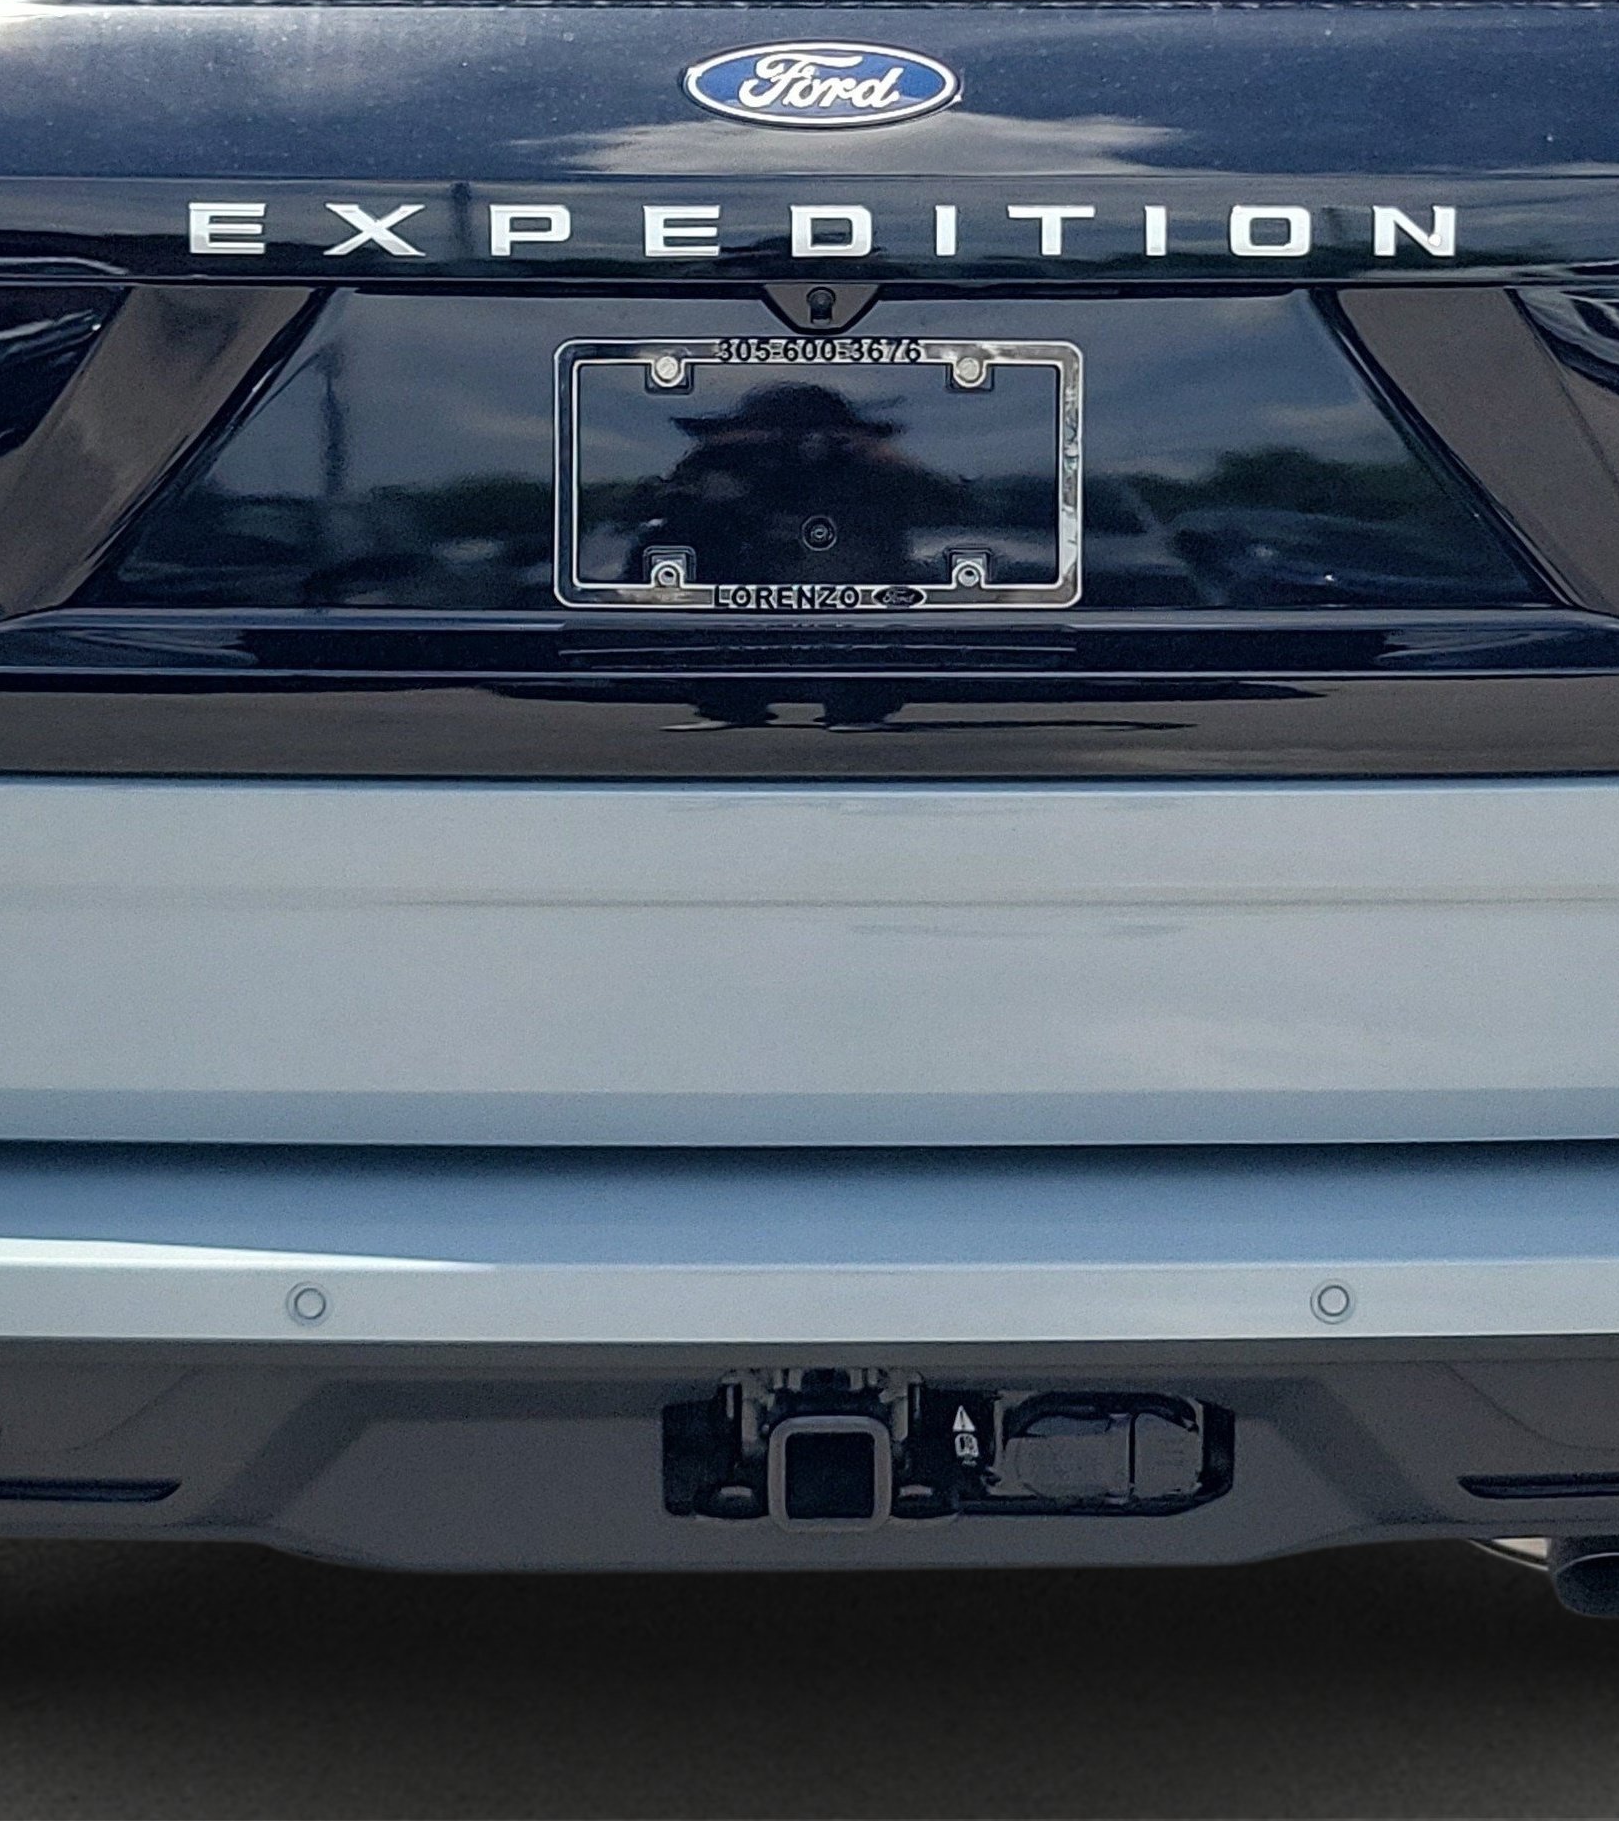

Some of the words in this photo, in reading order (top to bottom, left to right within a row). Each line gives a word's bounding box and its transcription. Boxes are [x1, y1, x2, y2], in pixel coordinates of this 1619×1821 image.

[738, 52, 904, 108] Ford
[188, 202, 1459, 259] EXPEDITION
[716, 339, 922, 362] 305-600-3676
[714, 586, 860, 609] LORENZO
